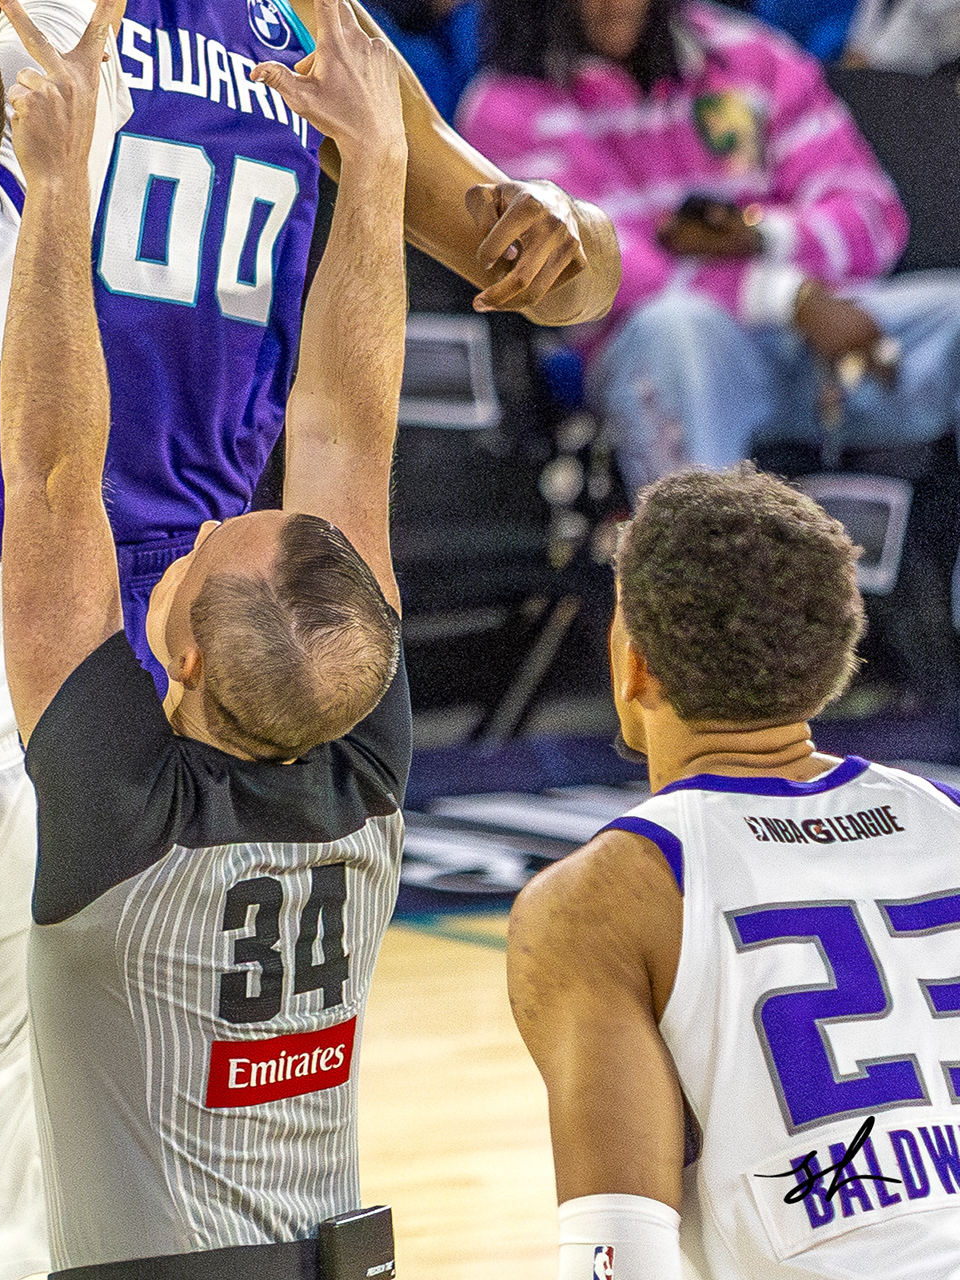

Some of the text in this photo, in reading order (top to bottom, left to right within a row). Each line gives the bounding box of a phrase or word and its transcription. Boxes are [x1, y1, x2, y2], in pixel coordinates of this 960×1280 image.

[96, 131, 300, 327] 00
[760, 805, 906, 845] NBA G LEAGUE
[219, 861, 350, 1024] 34
[227, 1042, 346, 1090] Emirates
[789, 1124, 960, 1230] BALDW
